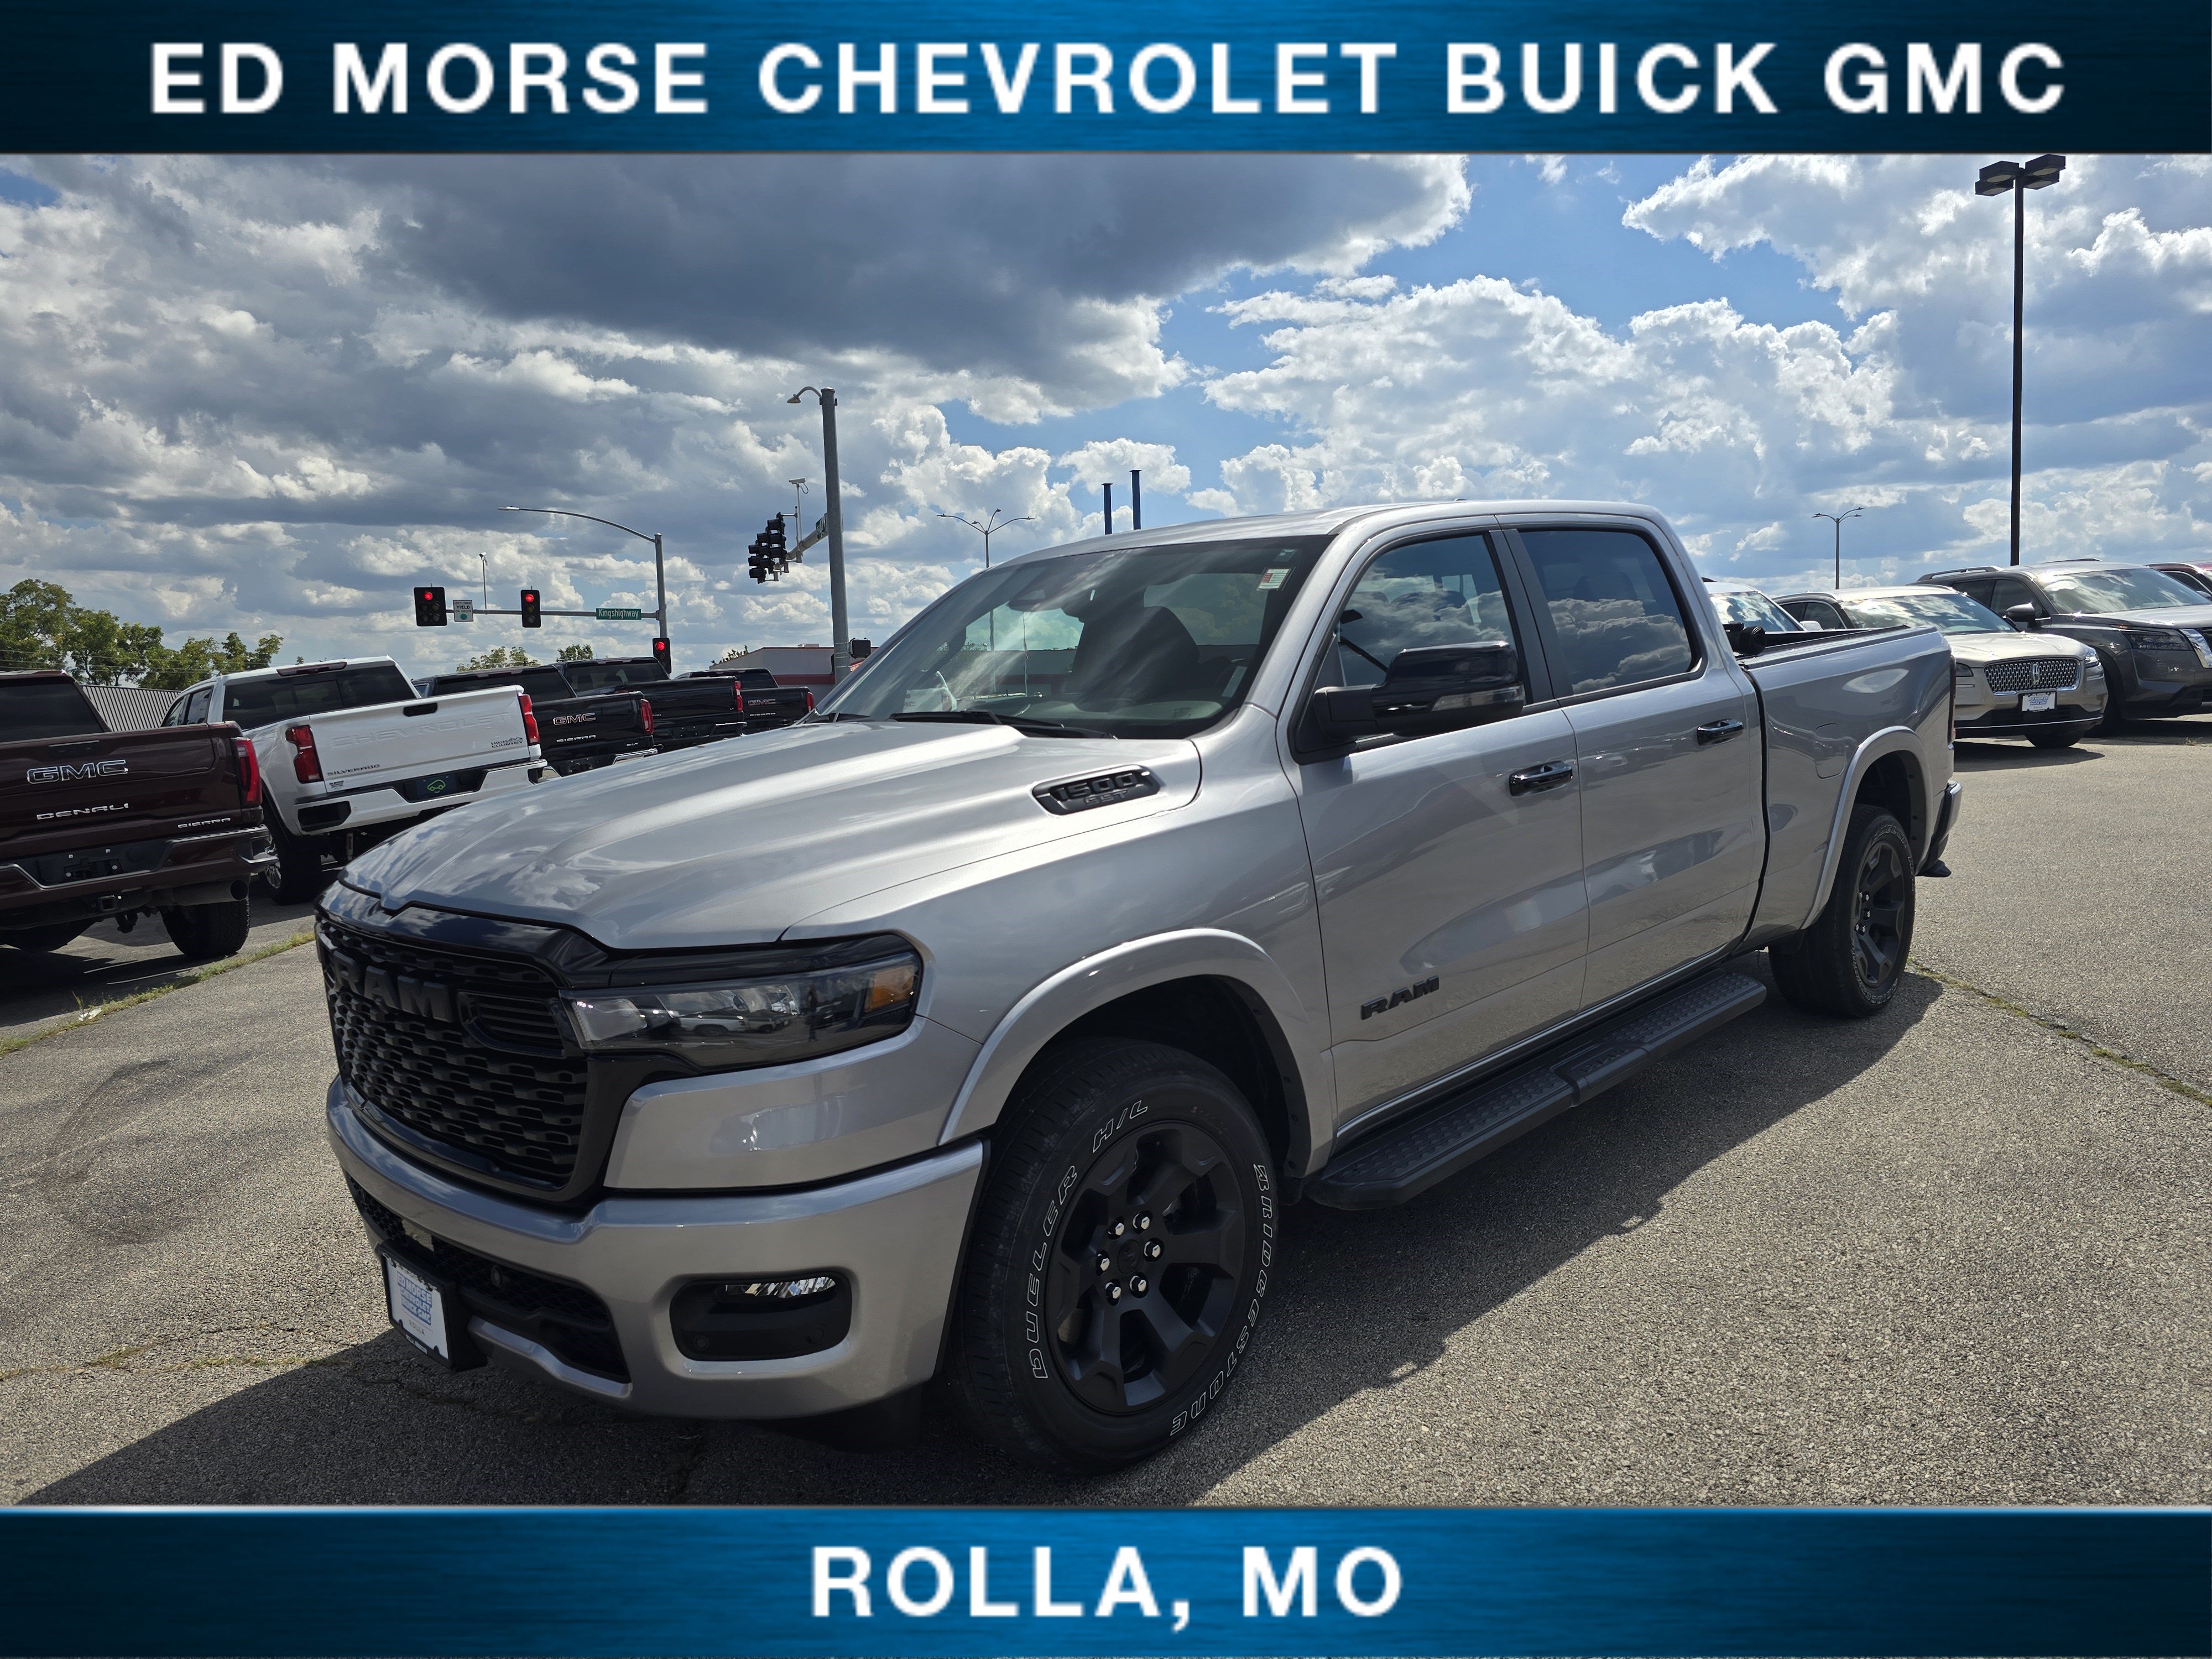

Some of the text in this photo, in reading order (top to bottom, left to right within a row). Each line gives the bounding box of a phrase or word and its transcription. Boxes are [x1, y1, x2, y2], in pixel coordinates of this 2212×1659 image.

[598, 609, 639, 619] Kingshighway
[332, 712, 509, 749] CHEVROLET
[553, 712, 596, 726] GMC
[556, 734, 597, 743] SIERRA
[27, 759, 128, 784] GMC
[327, 764, 380, 776] SILVERADO
[1056, 773, 1138, 801] 1500
[36, 802, 129, 821] DENALI
[178, 817, 231, 828] SIERRA
[332, 950, 455, 1023] RAM
[1360, 975, 1439, 1021] RAM
[1024, 1100, 1149, 1379] DUELER H/L
[406, 1278, 431, 1307] MORSE
[1169, 1164, 1273, 1436] BRIDGESTONE
[418, 1309, 431, 1325] GMC
